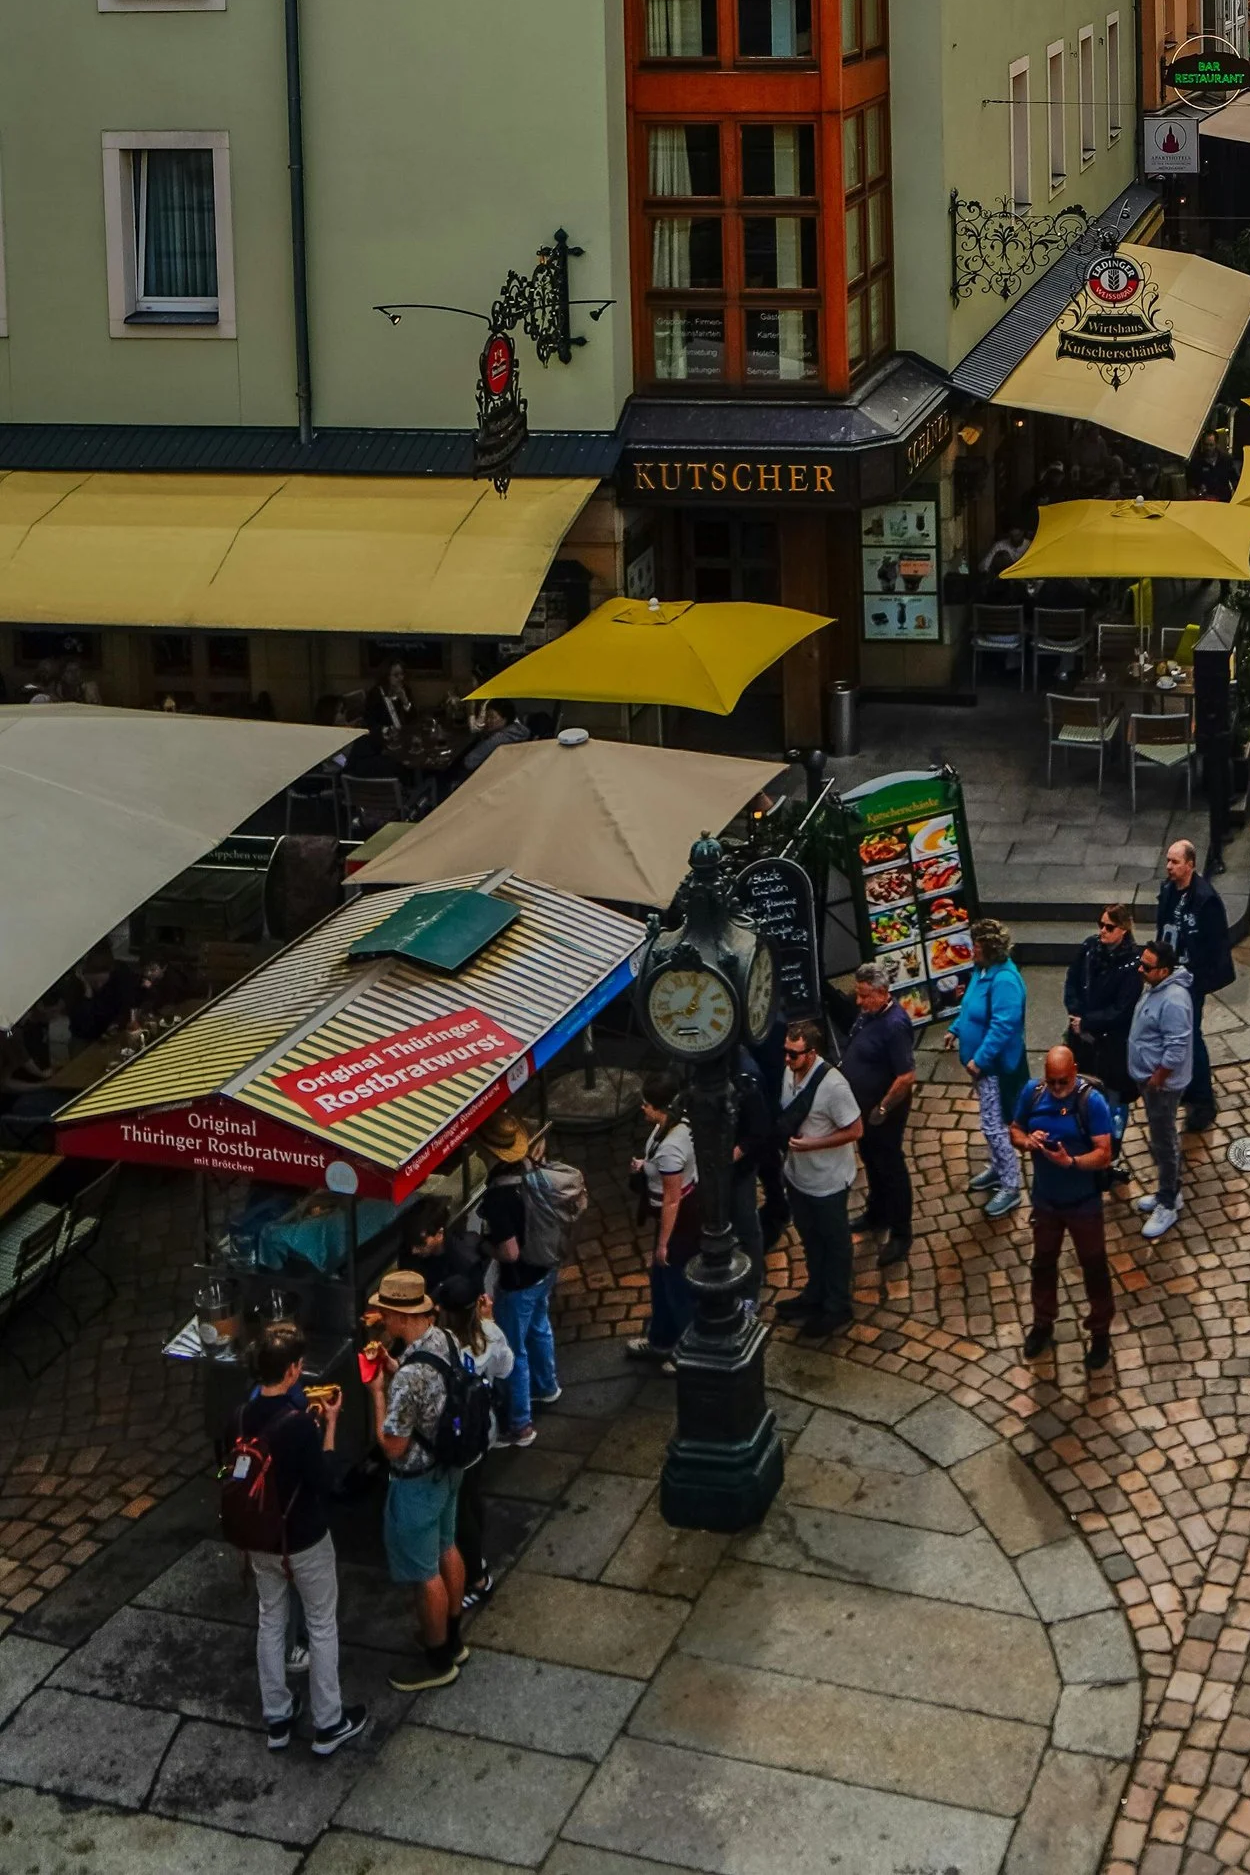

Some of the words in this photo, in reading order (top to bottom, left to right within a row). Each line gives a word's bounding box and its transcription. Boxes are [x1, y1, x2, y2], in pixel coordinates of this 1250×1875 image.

[1198, 61, 1221, 72] BAR
[1174, 73, 1246, 84] RESTAURANT
[1092, 259, 1136, 278] ERDINGER
[1087, 321, 1144, 334] Wirtshaus
[1062, 340, 1170, 359] Kutscherschänke
[634, 462, 836, 493] KUTSCHER
[296, 1051, 384, 1094] Original
[382, 1018, 481, 1061] Thüringer
[313, 1032, 506, 1114] Rostbratwurst
[188, 1113, 257, 1137] Original
[120, 1124, 203, 1152] Thüringer
[208, 1136, 326, 1169] Rostbratwurst
[193, 1156, 210, 1167] mit
[212, 1158, 255, 1173] Brötchen
